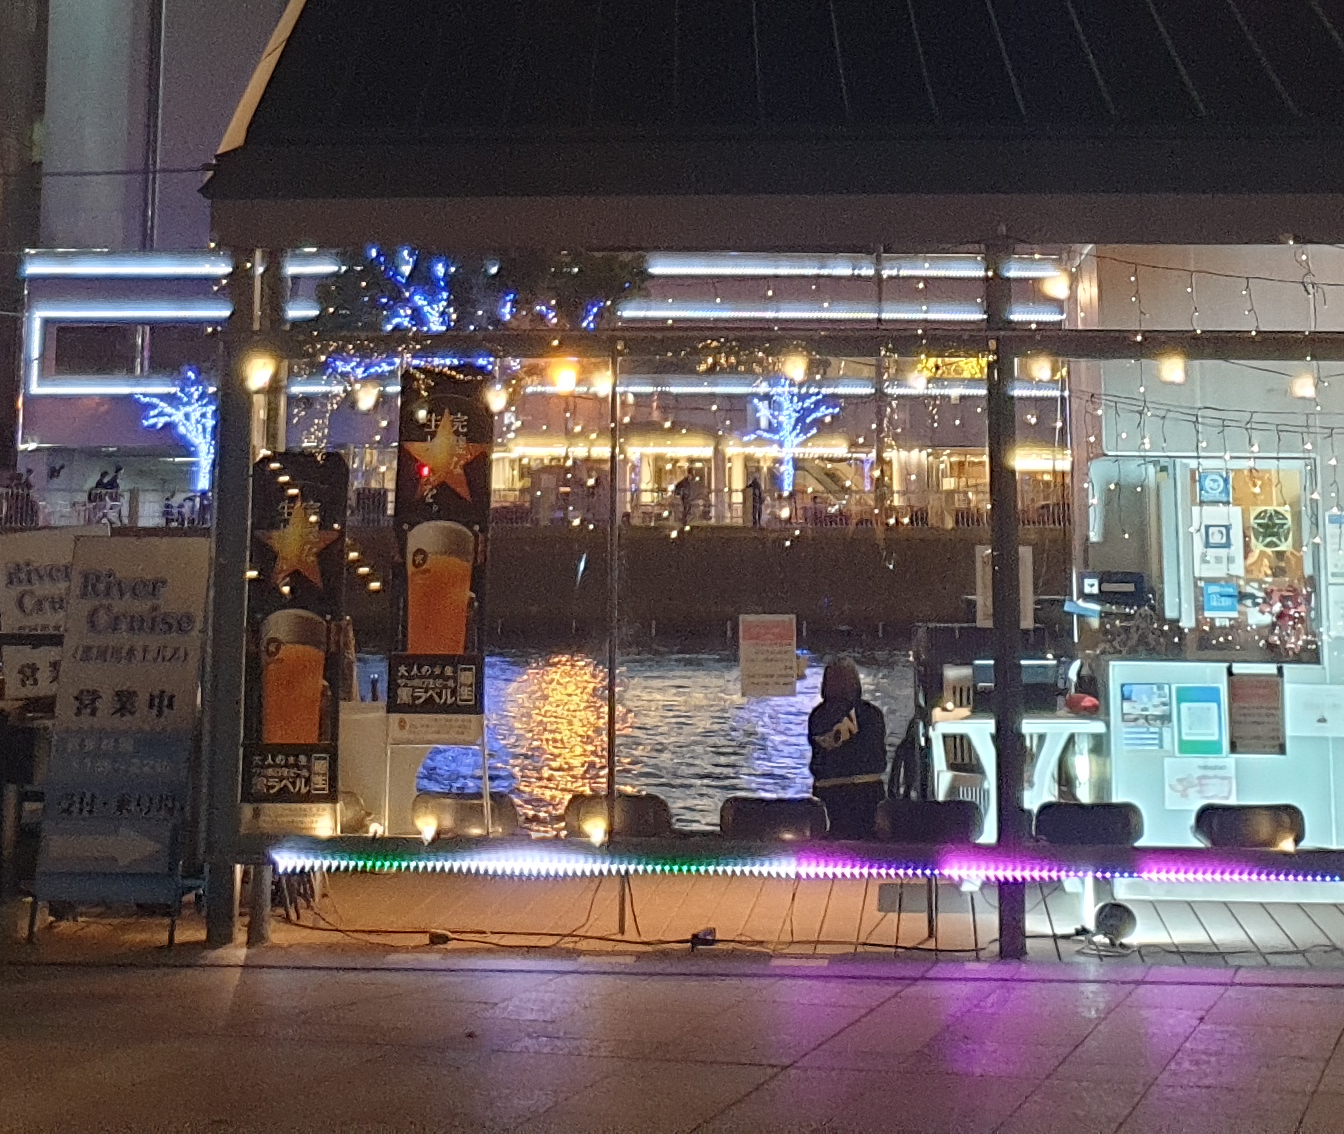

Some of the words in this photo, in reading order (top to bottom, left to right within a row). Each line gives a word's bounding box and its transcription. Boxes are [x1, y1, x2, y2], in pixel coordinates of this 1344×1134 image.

[79, 568, 169, 601] River
[86, 602, 196, 636] Cruise
[72, 687, 177, 718] 営業中
